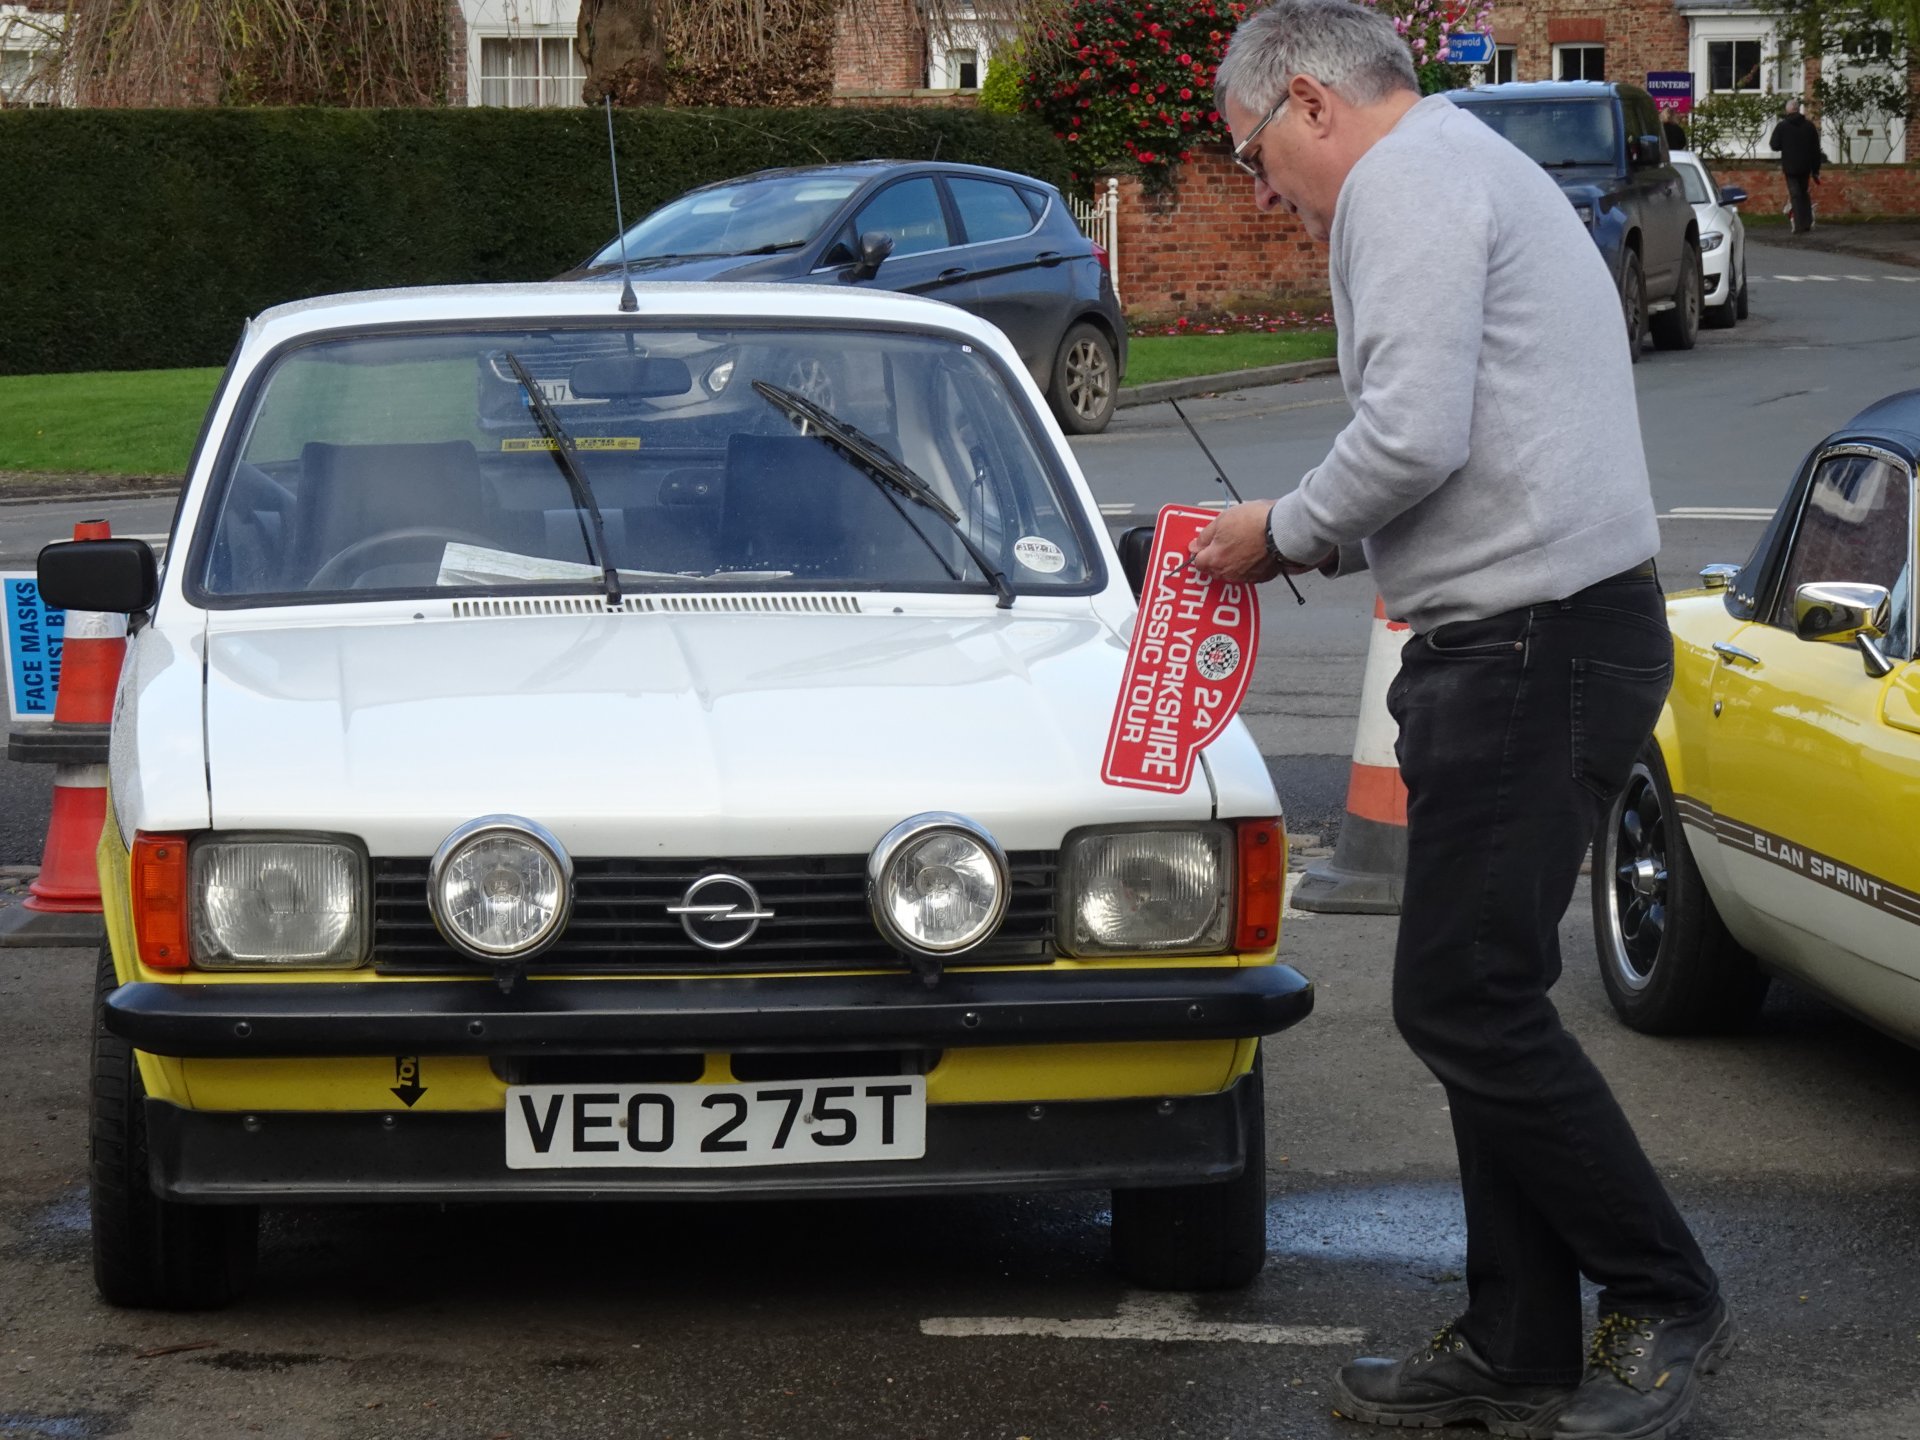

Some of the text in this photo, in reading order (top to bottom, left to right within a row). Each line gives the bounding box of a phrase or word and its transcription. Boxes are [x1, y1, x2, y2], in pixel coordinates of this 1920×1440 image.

[1448, 37, 1481, 49] ingwold
[1648, 80, 1690, 89] HUNTERS
[540, 385, 566, 401] L17
[16, 582, 46, 711] FACE MASKS
[1122, 551, 1184, 743] CLASSIC TOUR
[1192, 583, 1242, 730] 20 24
[1141, 627, 1197, 778] YORKSHIRE
[1754, 833, 1882, 901] ELAN SPRINT
[518, 1085, 912, 1154] VEO 275T
